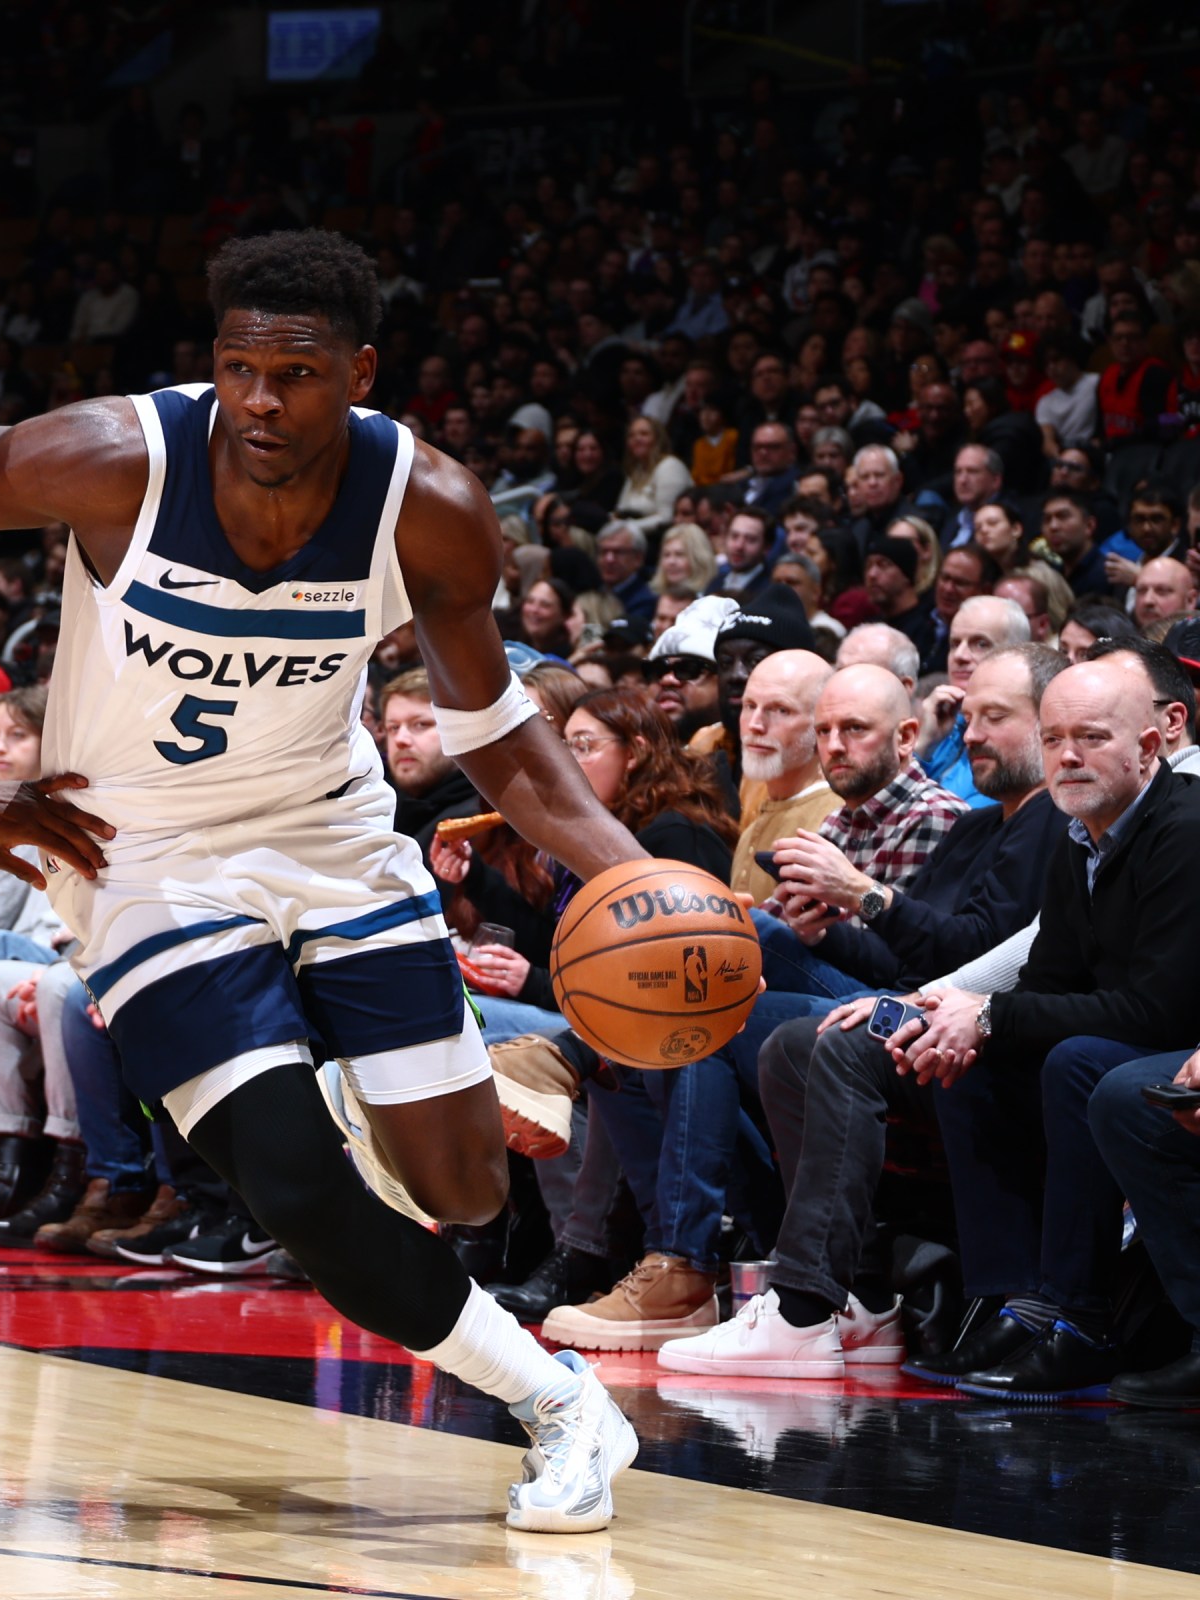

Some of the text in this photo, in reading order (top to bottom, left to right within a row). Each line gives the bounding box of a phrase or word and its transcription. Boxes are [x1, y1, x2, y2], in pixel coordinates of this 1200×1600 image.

[275, 20, 376, 68] IBM
[304, 588, 355, 602] sezzle
[124, 618, 348, 688] WOLVES
[153, 694, 238, 765] 5
[607, 885, 744, 929] Wilson
